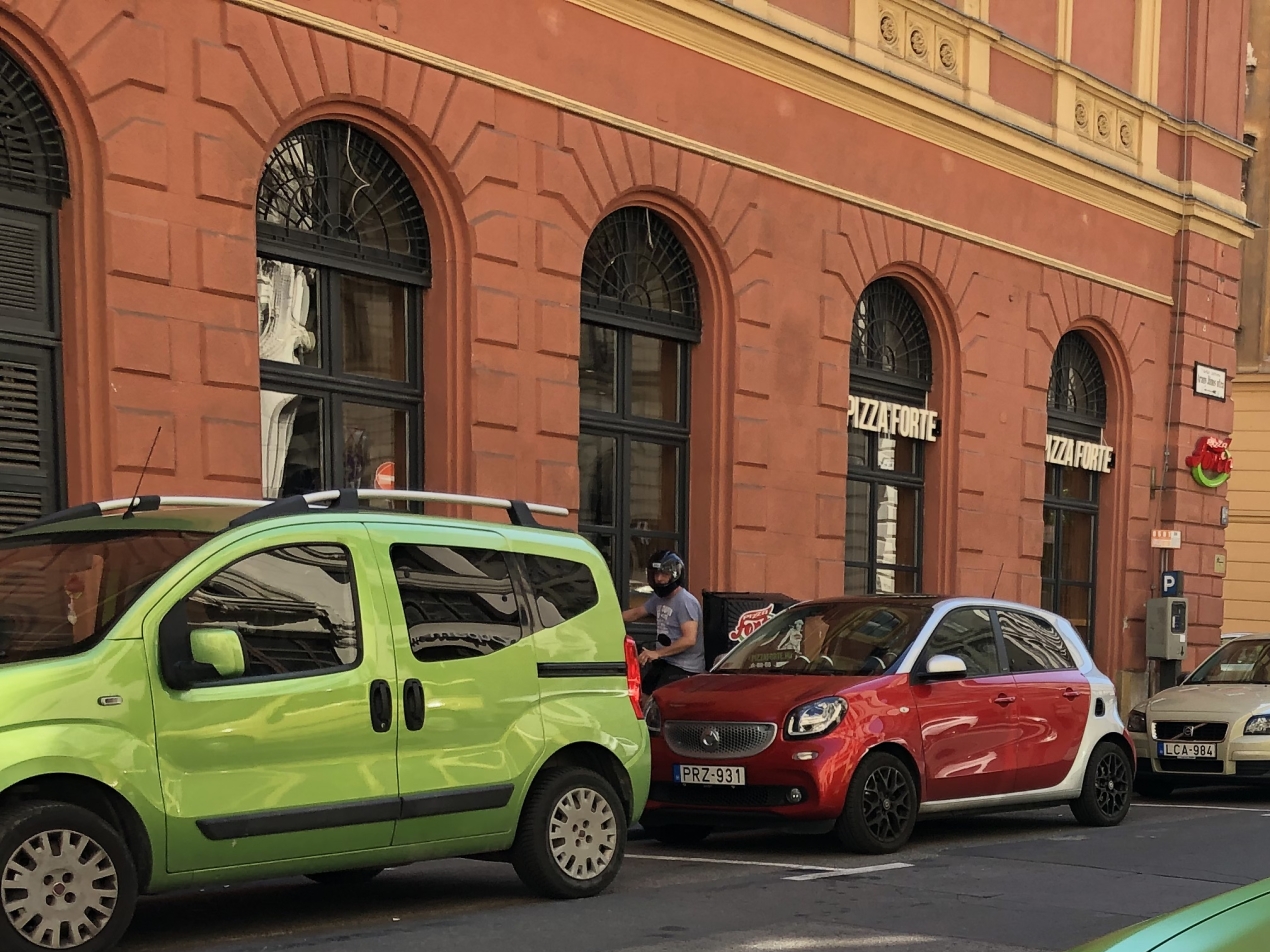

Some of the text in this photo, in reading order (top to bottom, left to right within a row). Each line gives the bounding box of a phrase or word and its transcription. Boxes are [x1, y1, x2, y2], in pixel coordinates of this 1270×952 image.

[891, 402, 938, 442] FORTE
[1045, 433, 1113, 474] IZZA FORTE
[1163, 575, 1176, 592] P
[1165, 744, 1212, 756] LCA-984
[682, 766, 741, 783] PRZ-931
